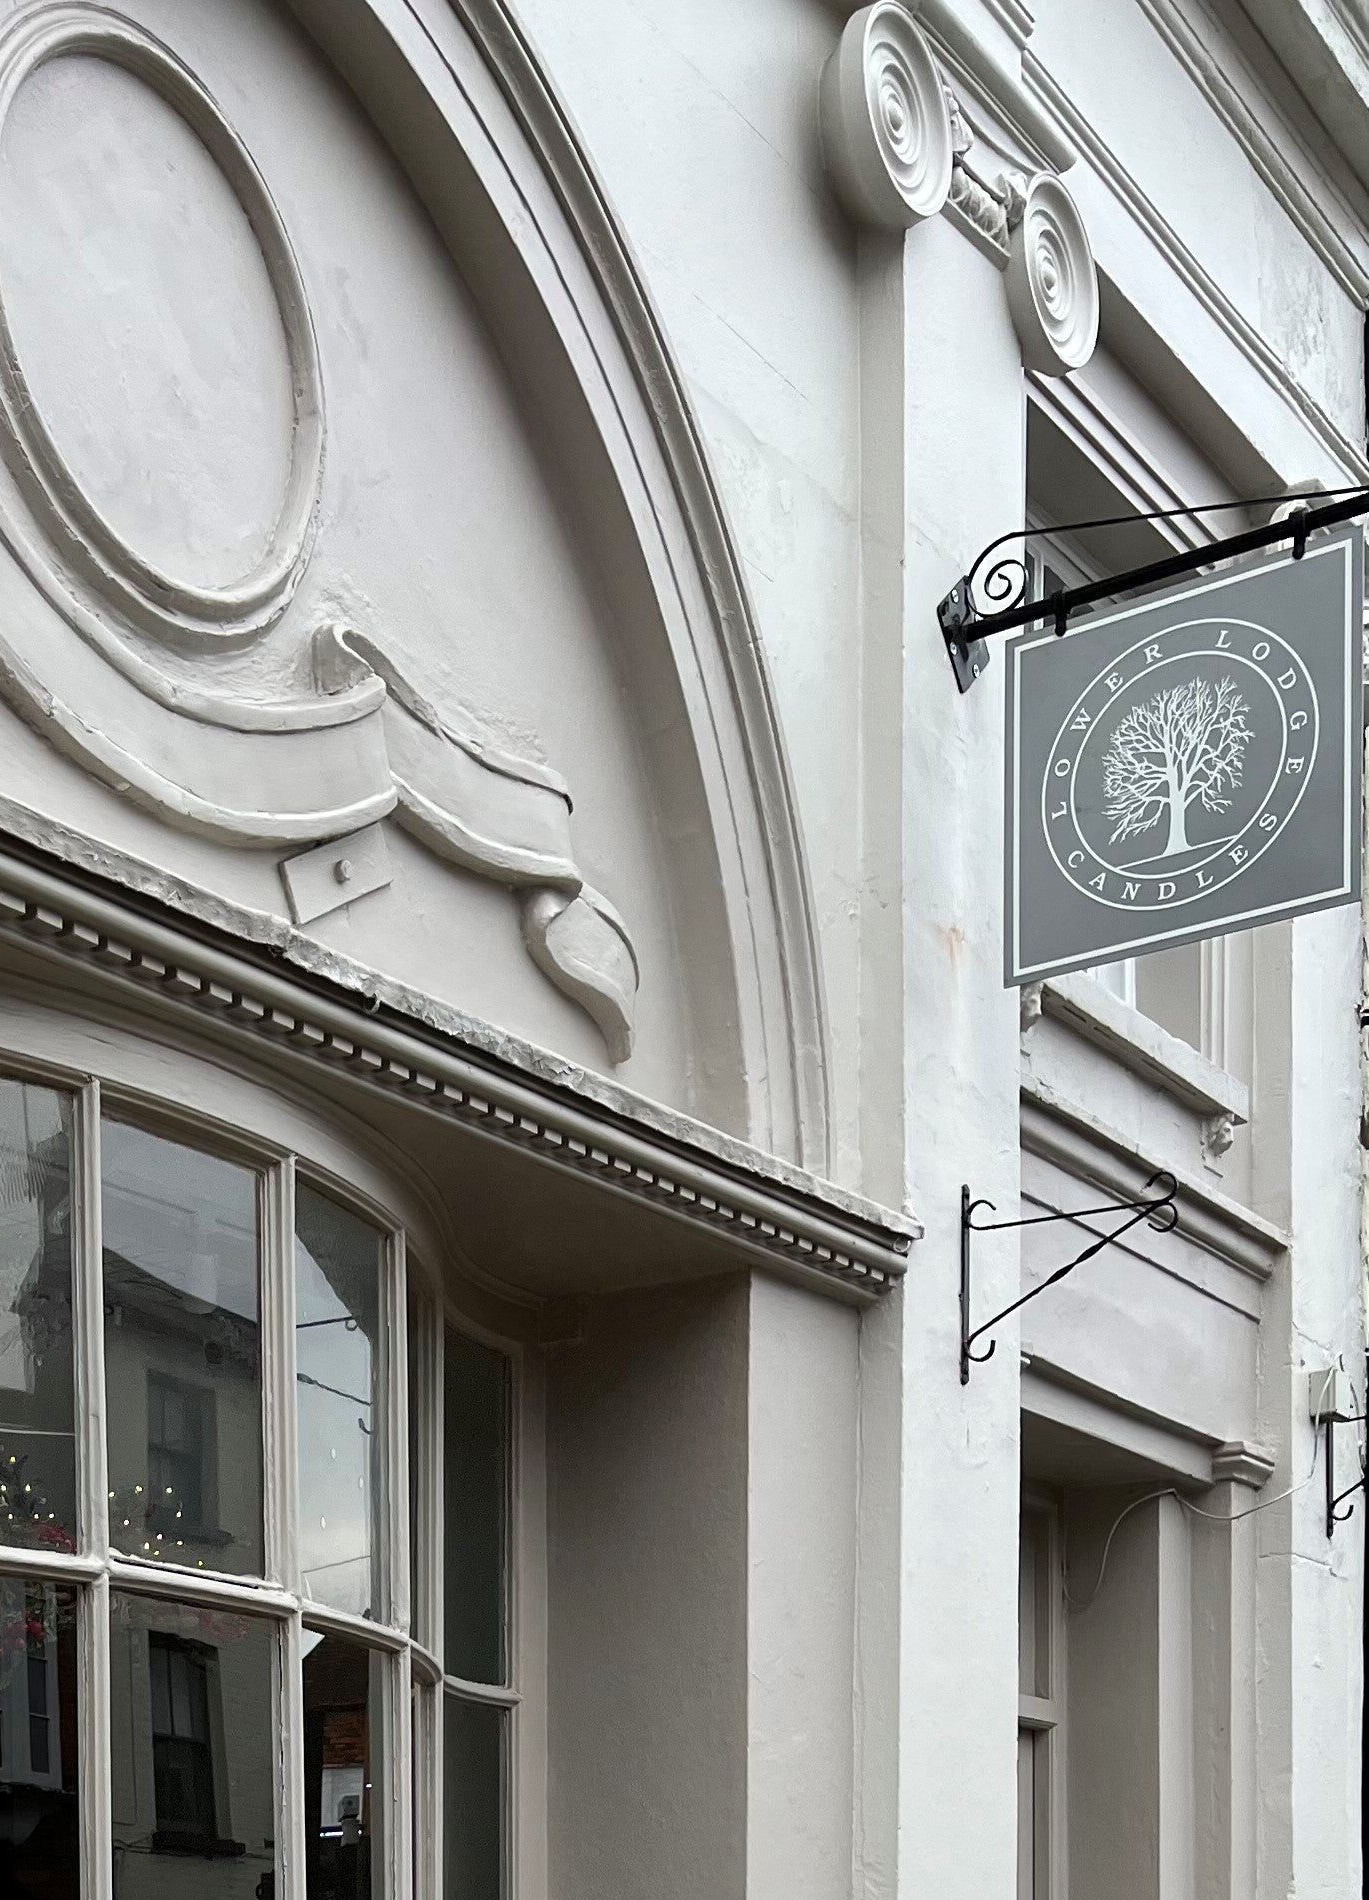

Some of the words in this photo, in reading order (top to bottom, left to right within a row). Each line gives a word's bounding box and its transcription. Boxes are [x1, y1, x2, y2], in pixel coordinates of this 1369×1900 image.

[1051, 643, 1163, 820] LOWER
[1215, 629, 1308, 775] LODGE
[1067, 812, 1278, 901] CANDLES
